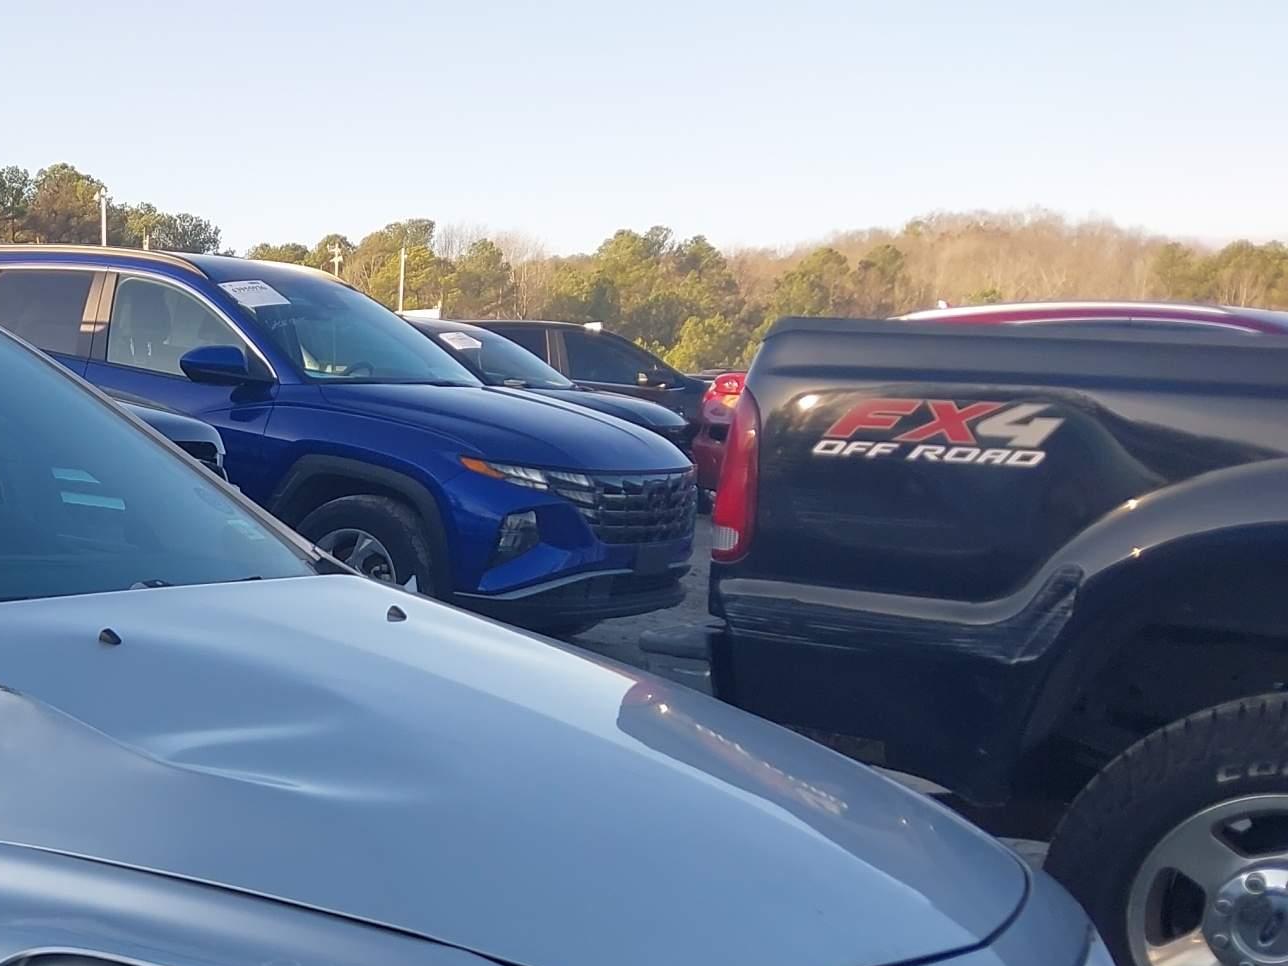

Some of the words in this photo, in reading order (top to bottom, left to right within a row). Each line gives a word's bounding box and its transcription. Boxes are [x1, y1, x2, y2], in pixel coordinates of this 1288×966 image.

[823, 399, 1065, 447] FX4
[812, 440, 900, 457] OFF
[906, 444, 1046, 466] ROAD
